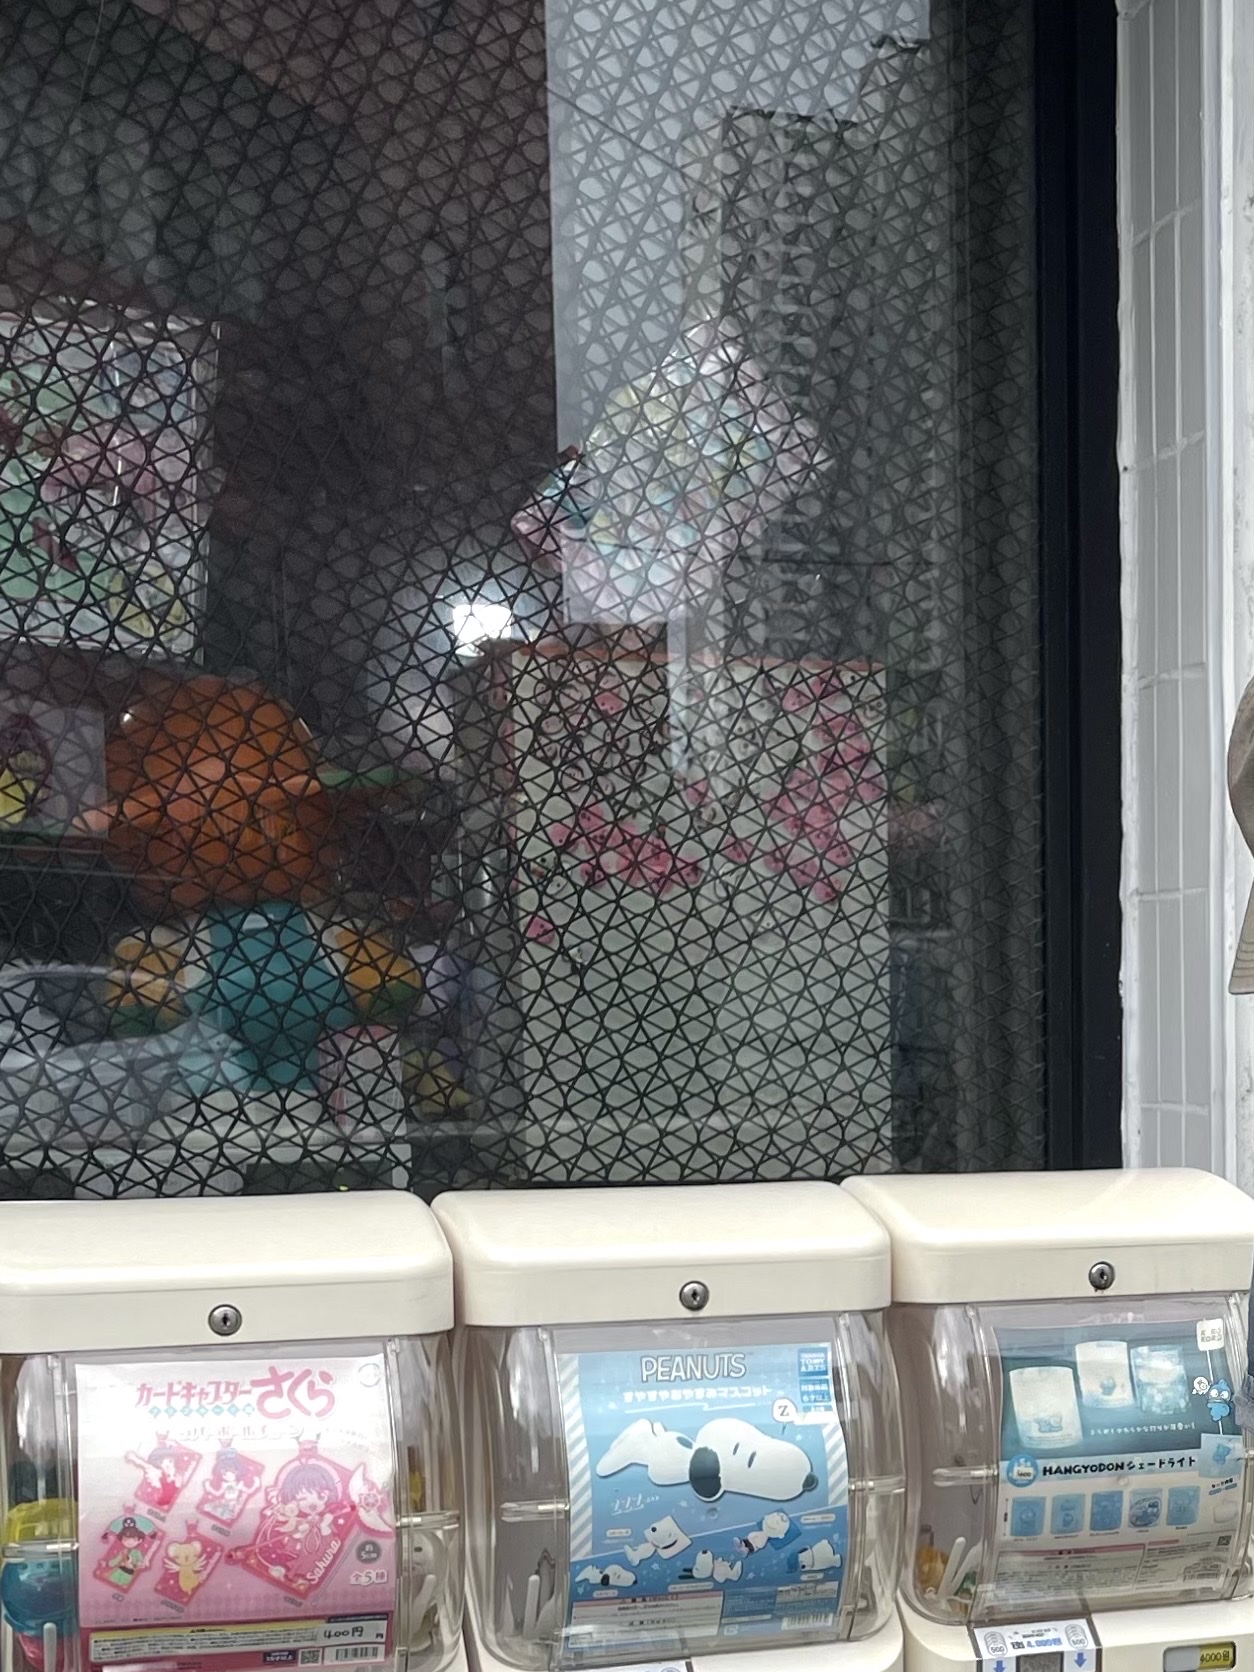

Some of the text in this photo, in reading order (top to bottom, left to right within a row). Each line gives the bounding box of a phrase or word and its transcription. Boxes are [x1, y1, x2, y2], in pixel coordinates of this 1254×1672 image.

[640, 1352, 747, 1383] PEANUTS
[307, 1539, 341, 1584] Sakura
[323, 1625, 364, 1641] 400円
